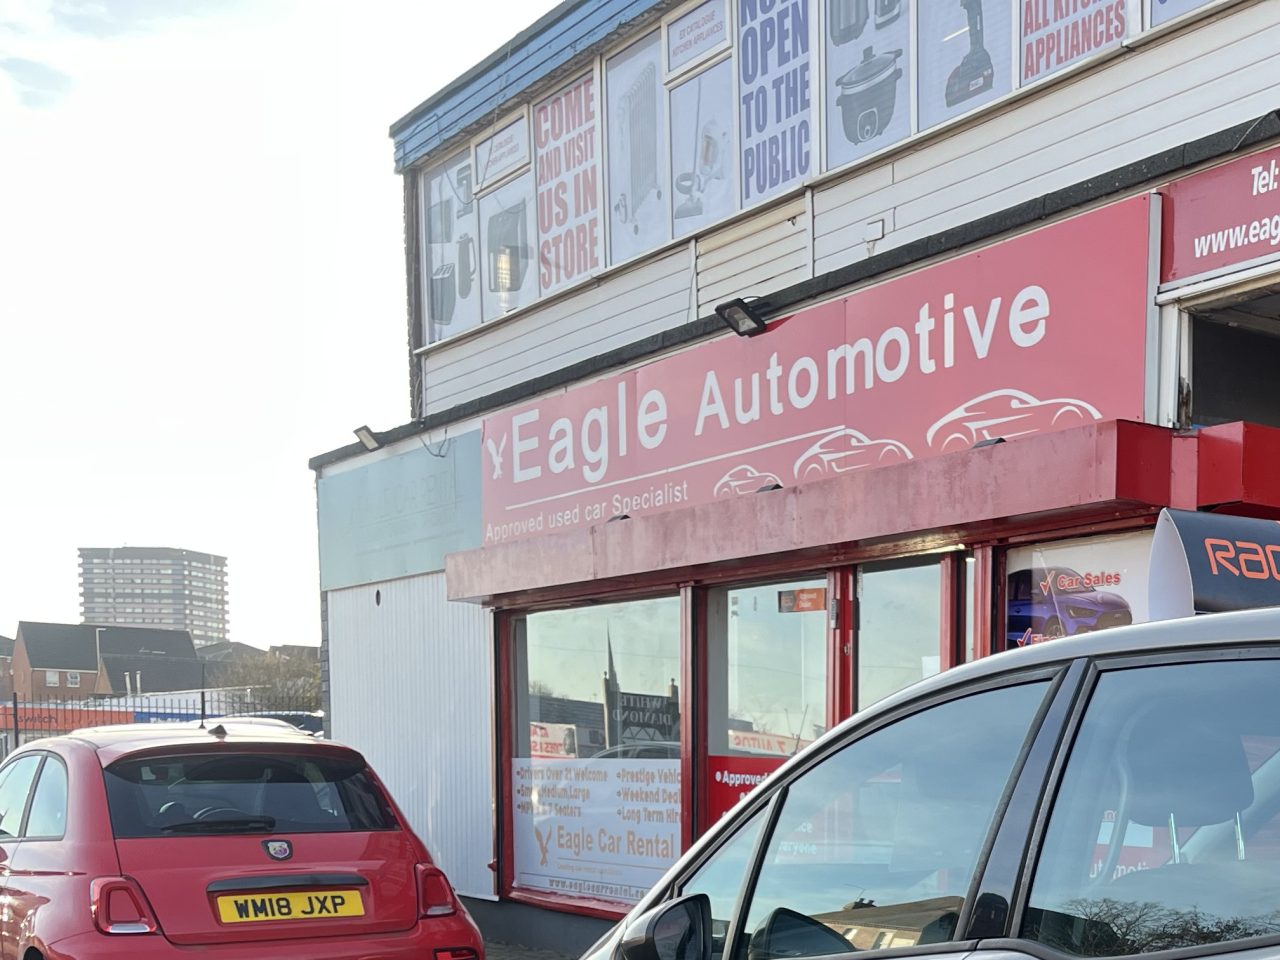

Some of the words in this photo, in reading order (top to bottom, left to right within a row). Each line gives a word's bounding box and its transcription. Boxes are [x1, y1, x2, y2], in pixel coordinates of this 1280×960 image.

[742, 1, 809, 85] OPEN
[1024, 0, 1050, 37] ALL
[1024, 0, 1125, 80] APPLIANCES
[536, 79, 595, 149] COME
[743, 85, 768, 139] TO
[772, 61, 810, 124] THE
[538, 146, 561, 187] AND
[564, 125, 595, 172] VISIT
[744, 119, 810, 200] PUBLIC
[1251, 160, 1279, 196] Tel:
[539, 181, 568, 234] US
[573, 164, 597, 219] IN
[539, 217, 599, 289] STORE
[512, 381, 668, 483] Eagle
[694, 284, 1051, 436] Automotive
[485, 511, 543, 542] Approved
[548, 504, 579, 529] used
[584, 501, 606, 521] car
[612, 480, 688, 516] Specialist
[1057, 575, 1080, 590] Car
[1083, 571, 1121, 588] Sales
[621, 768, 655, 786] Prestige
[621, 787, 659, 800] Weekend
[557, 825, 593, 856] Eagle
[598, 828, 622, 854] Car
[627, 830, 674, 859] Rental
[621, 807, 641, 824] Long
[643, 808, 665, 822] Term
[234, 897, 292, 918] WM18
[301, 895, 345, 915] JXP
